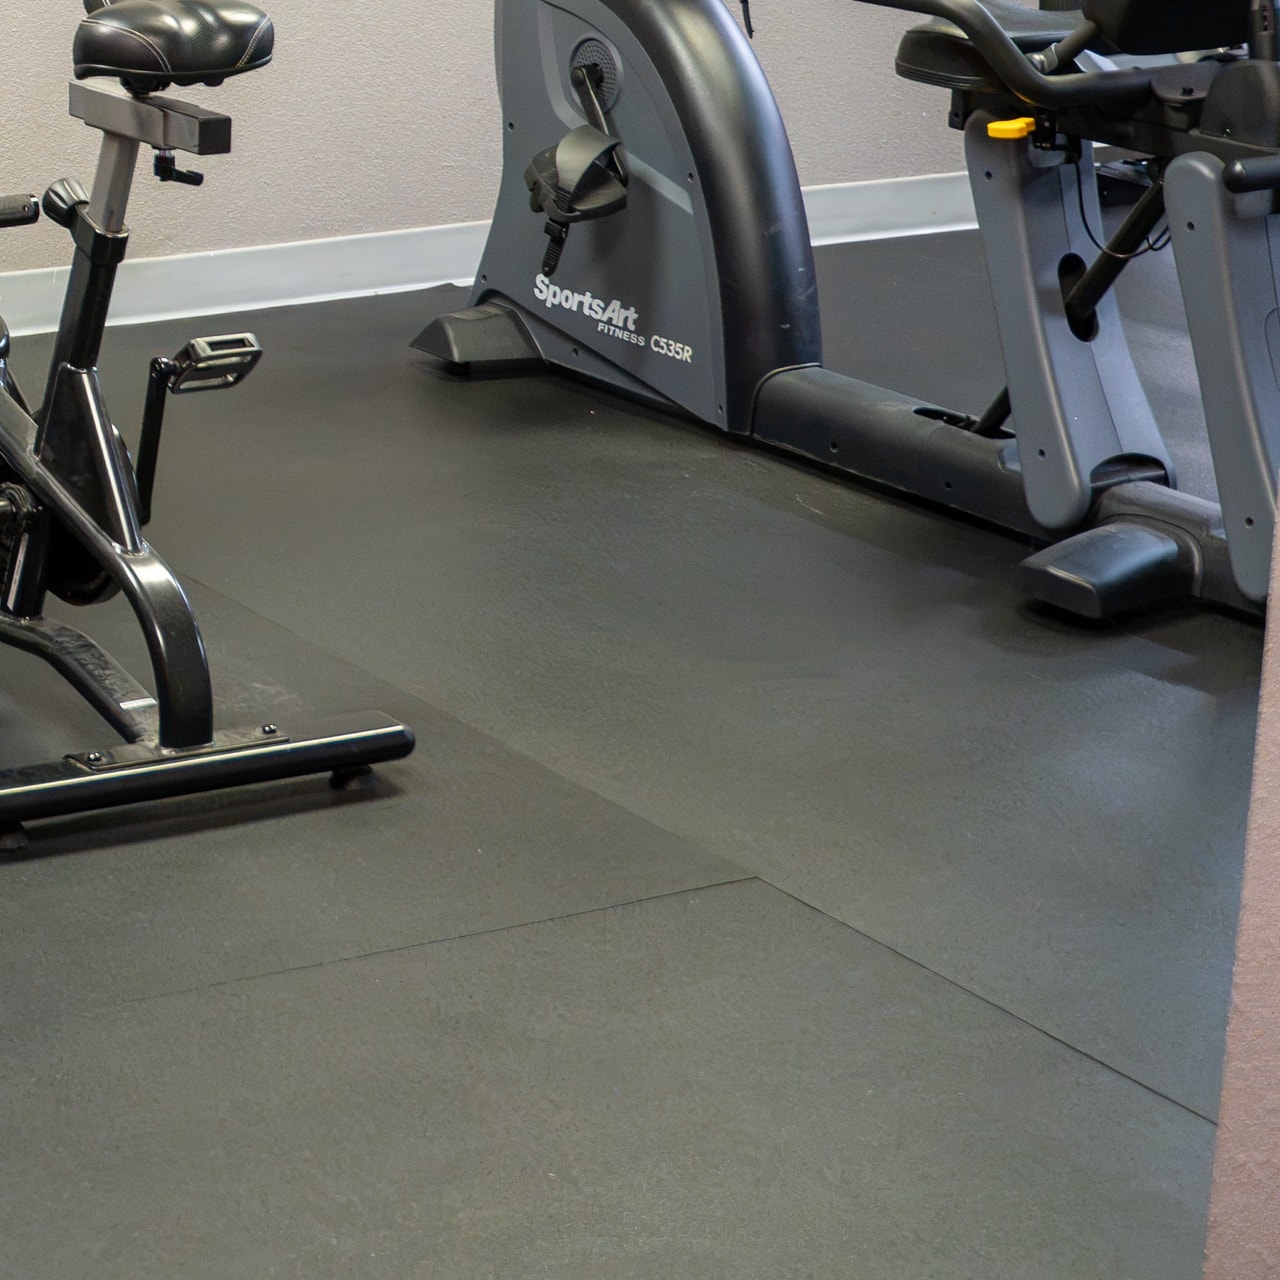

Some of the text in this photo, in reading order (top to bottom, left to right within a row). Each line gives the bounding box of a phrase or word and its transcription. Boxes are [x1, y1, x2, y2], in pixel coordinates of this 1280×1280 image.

[533, 273, 639, 332] SportsArt
[597, 322, 693, 363] FITNESS C535R
